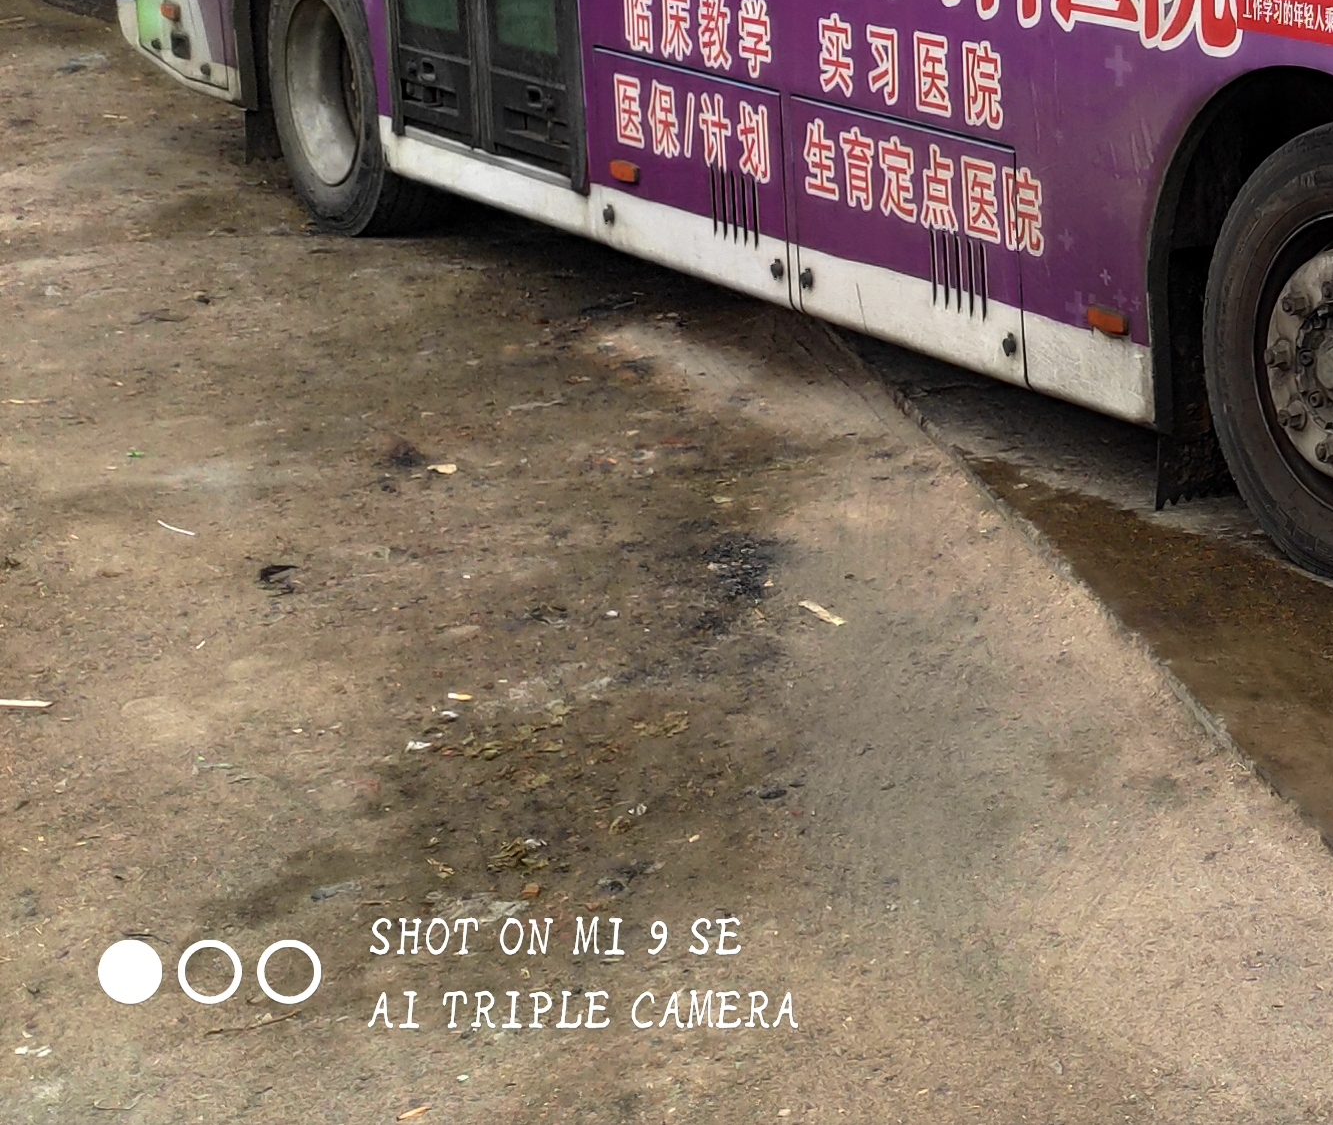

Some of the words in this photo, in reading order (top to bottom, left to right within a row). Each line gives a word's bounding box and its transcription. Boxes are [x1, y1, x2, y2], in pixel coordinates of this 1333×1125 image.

[818, 13, 1004, 130] 实习医院
[803, 118, 1044, 257] 生育定点医院
